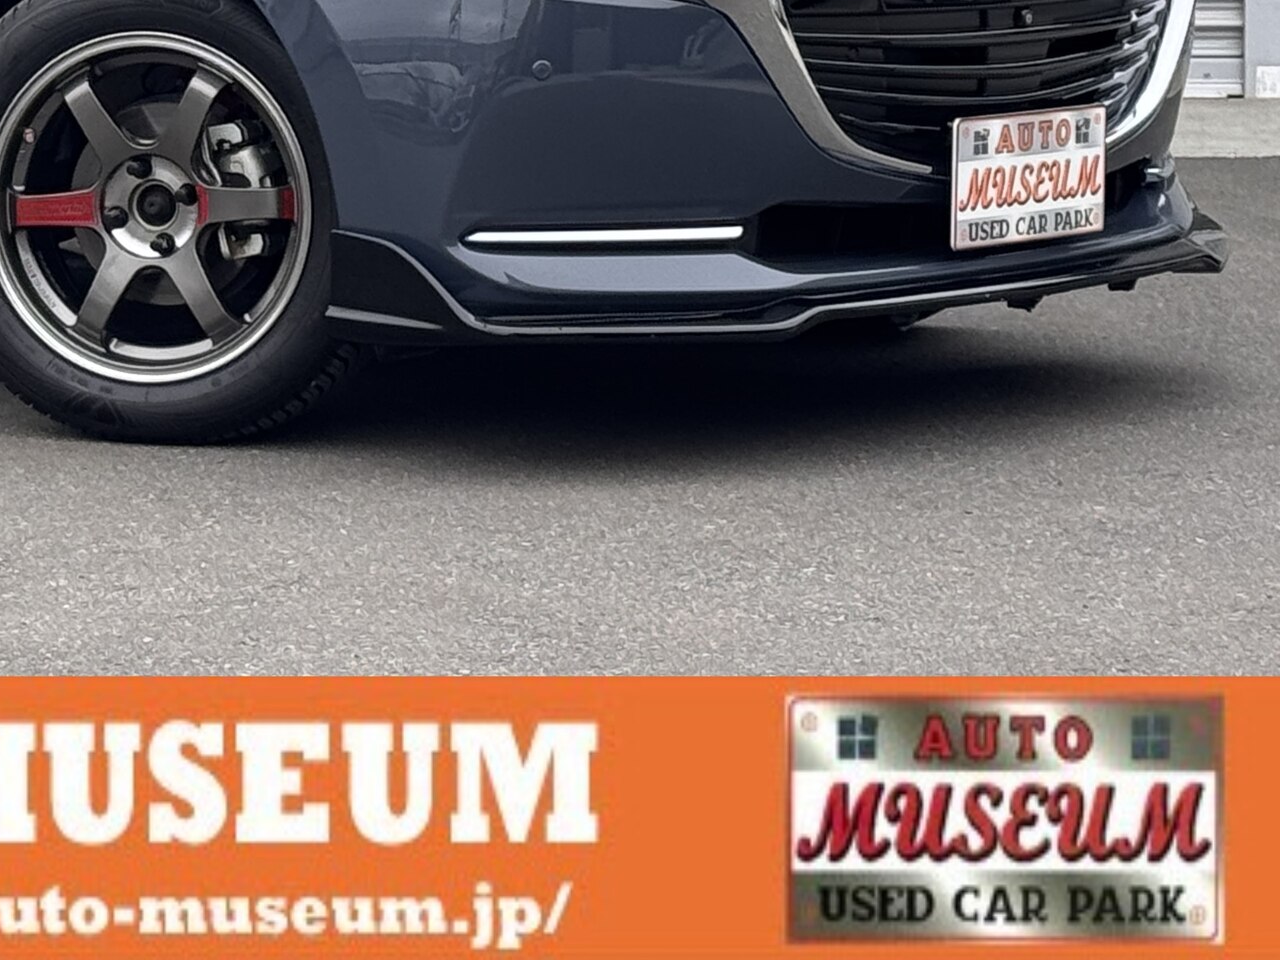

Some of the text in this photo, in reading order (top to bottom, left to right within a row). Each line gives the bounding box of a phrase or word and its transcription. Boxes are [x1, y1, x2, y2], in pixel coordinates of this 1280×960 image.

[995, 118, 1072, 155] AUTO
[958, 154, 1102, 213] MUSEUM
[968, 207, 1094, 242] USED CAR PARK
